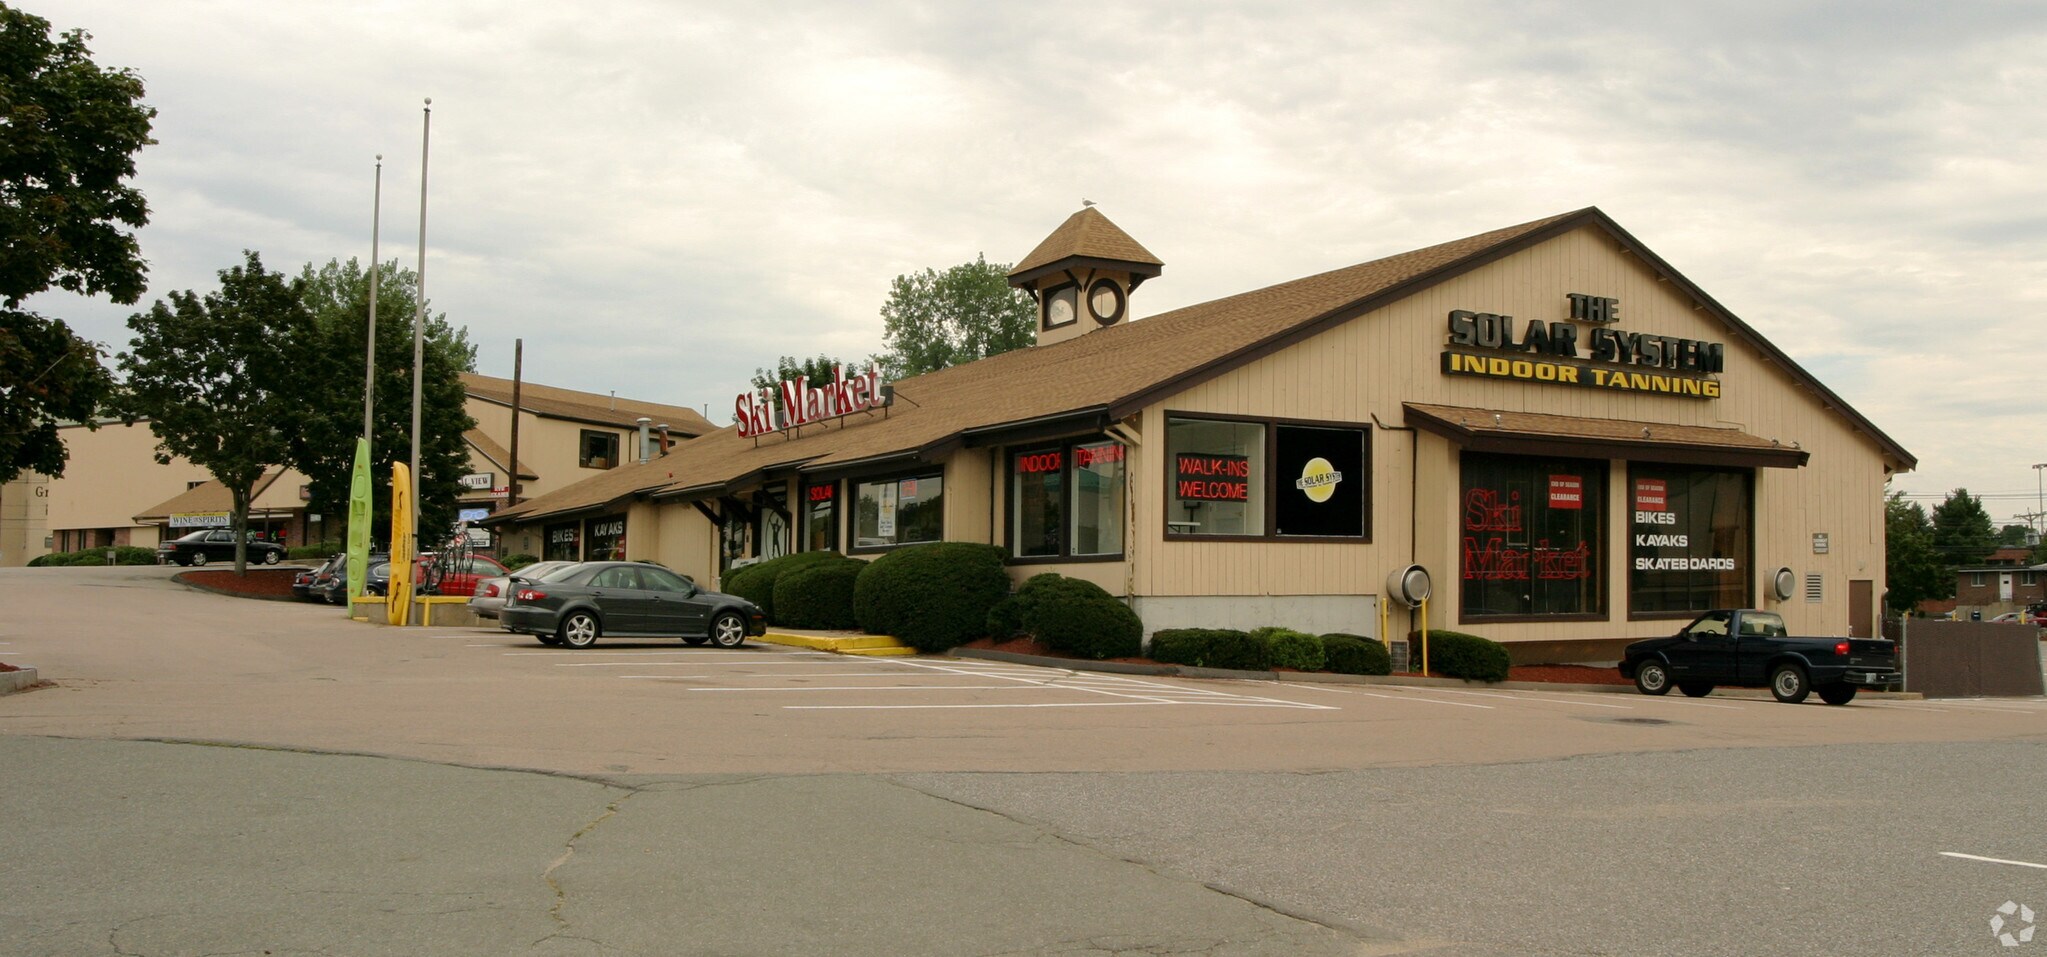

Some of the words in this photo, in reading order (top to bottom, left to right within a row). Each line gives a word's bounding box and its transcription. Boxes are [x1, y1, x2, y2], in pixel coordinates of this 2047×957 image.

[1566, 293, 1619, 322] THE
[1448, 309, 1577, 357] SOLAR
[1590, 327, 1723, 373] SYSTEM
[1451, 353, 1578, 383] INDOOR
[1591, 369, 1719, 397] TANNING
[735, 387, 774, 438] Ski
[779, 361, 885, 428] Market
[1179, 457, 1250, 477] WALK-INS
[1304, 473, 1325, 485] SOLAR
[1179, 480, 1249, 499] WELCOME
[1550, 493, 1580, 501] CLEARANCE
[1637, 496, 1664, 504] CLEARANCE
[1465, 488, 1522, 532] Ski
[1635, 511, 1676, 524] BIKES
[173, 516, 192, 524] WINE
[552, 528, 574, 543] BIKES
[594, 521, 623, 537] KAYAKS
[1636, 534, 1688, 547] KAYAKS
[1463, 536, 1591, 580] Market
[1635, 557, 1735, 570] SKATEBOARDS
